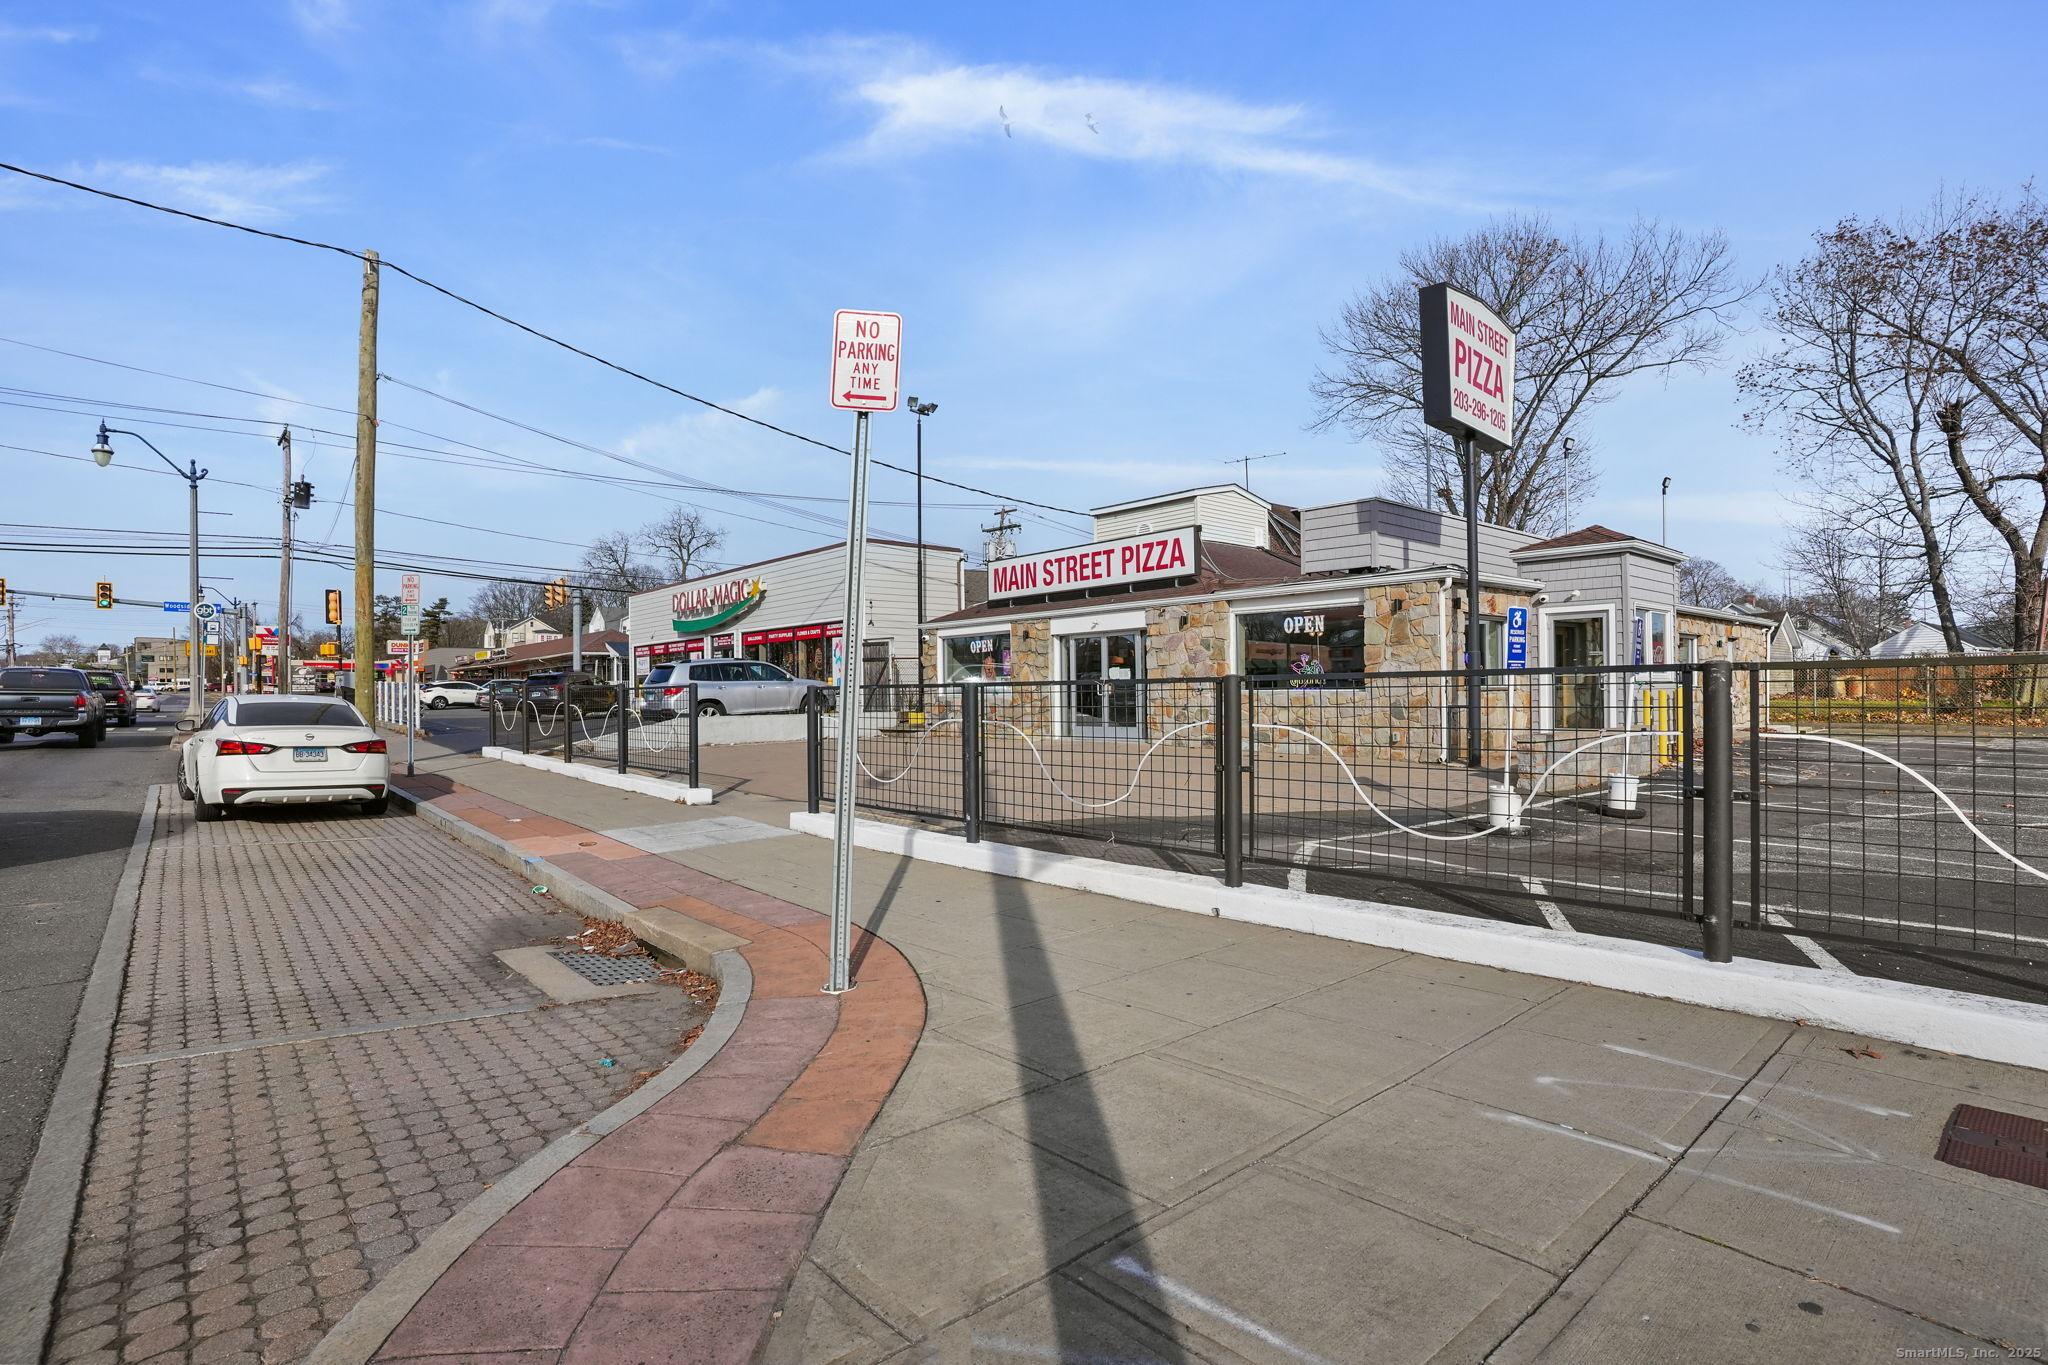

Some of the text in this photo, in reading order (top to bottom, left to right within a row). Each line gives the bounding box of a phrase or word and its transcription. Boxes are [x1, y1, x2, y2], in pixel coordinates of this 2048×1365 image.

[856, 320, 880, 339] NO
[1450, 301, 1508, 359] MAIN STREET
[838, 340, 895, 361] PARKING
[853, 362, 879, 375] ANY
[1454, 338, 1505, 404] PIZZA
[850, 376, 881, 390] TIME
[1454, 388, 1507, 432] 203-296-1205
[993, 537, 1186, 593] MAIN STREET PIZZA
[672, 578, 750, 612] DOLLAR MAGIC
[196, 606, 213, 615] gbt
[402, 606, 407, 615] 2
[1283, 614, 1325, 634] OPEN
[970, 639, 994, 654] OPEN
